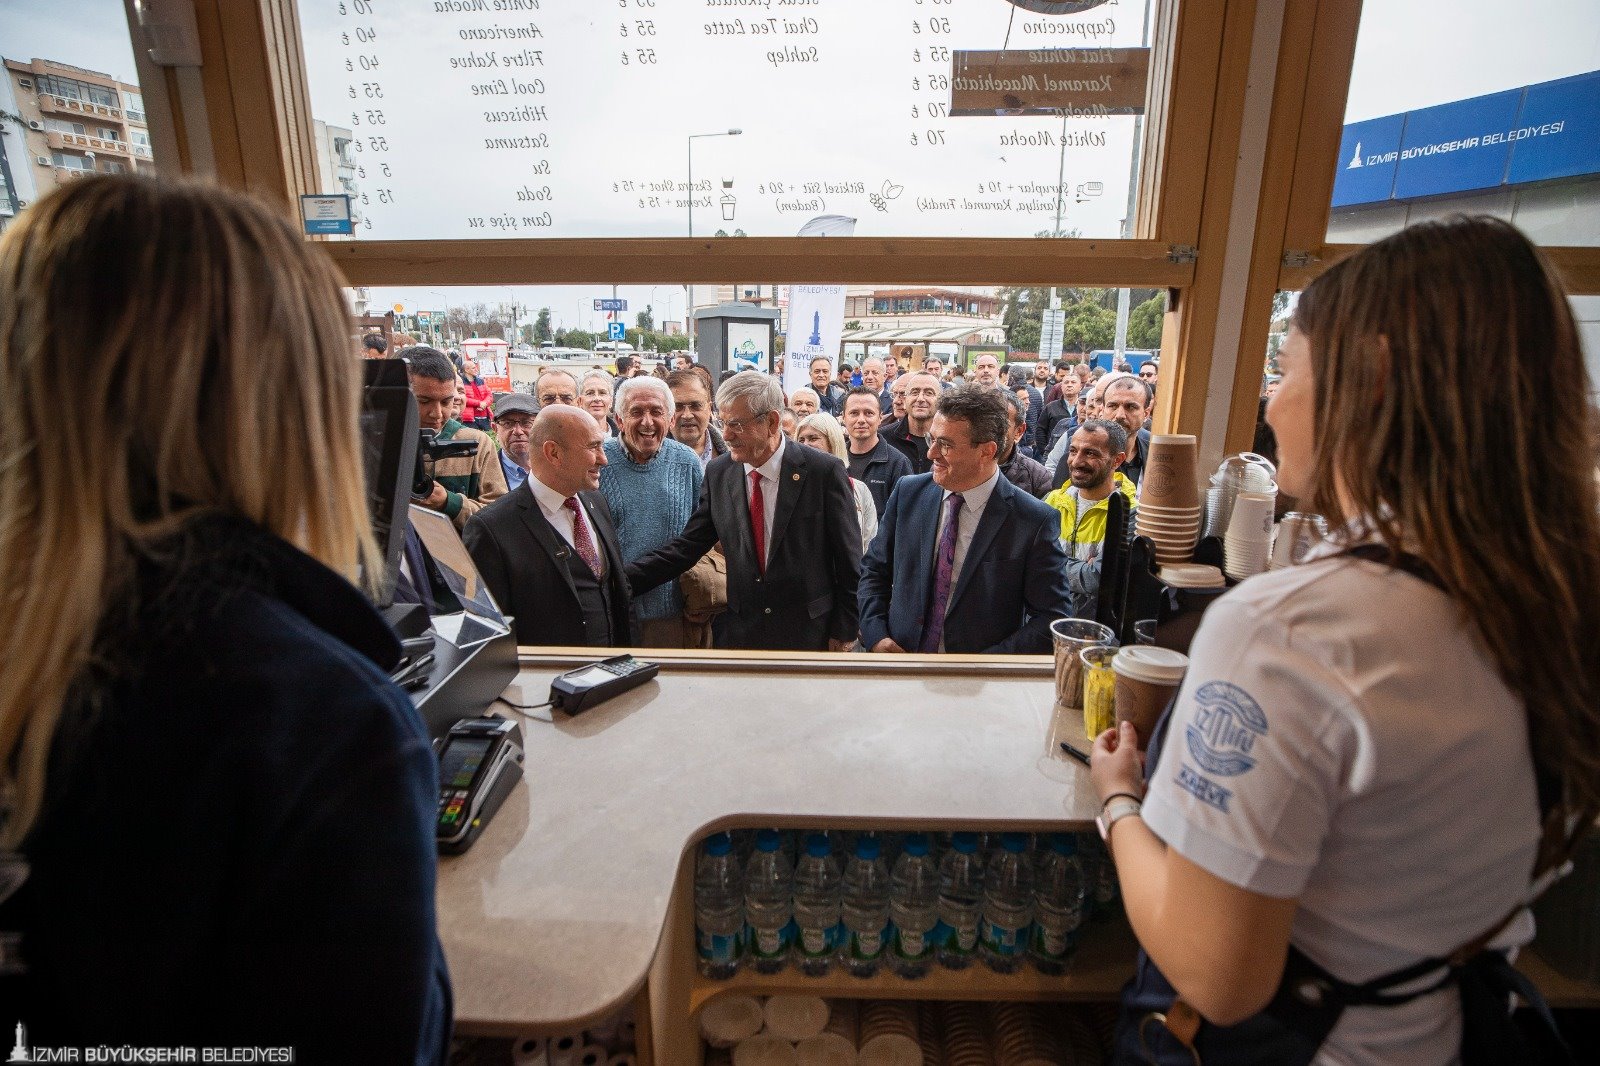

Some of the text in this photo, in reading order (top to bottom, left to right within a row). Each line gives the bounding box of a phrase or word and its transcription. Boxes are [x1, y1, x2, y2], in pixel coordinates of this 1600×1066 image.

[1400, 137, 1479, 161] BÜYÜKŞEHİR
[1481, 120, 1565, 147] BELEDİYESİ
[610, 323, 621, 340] P
